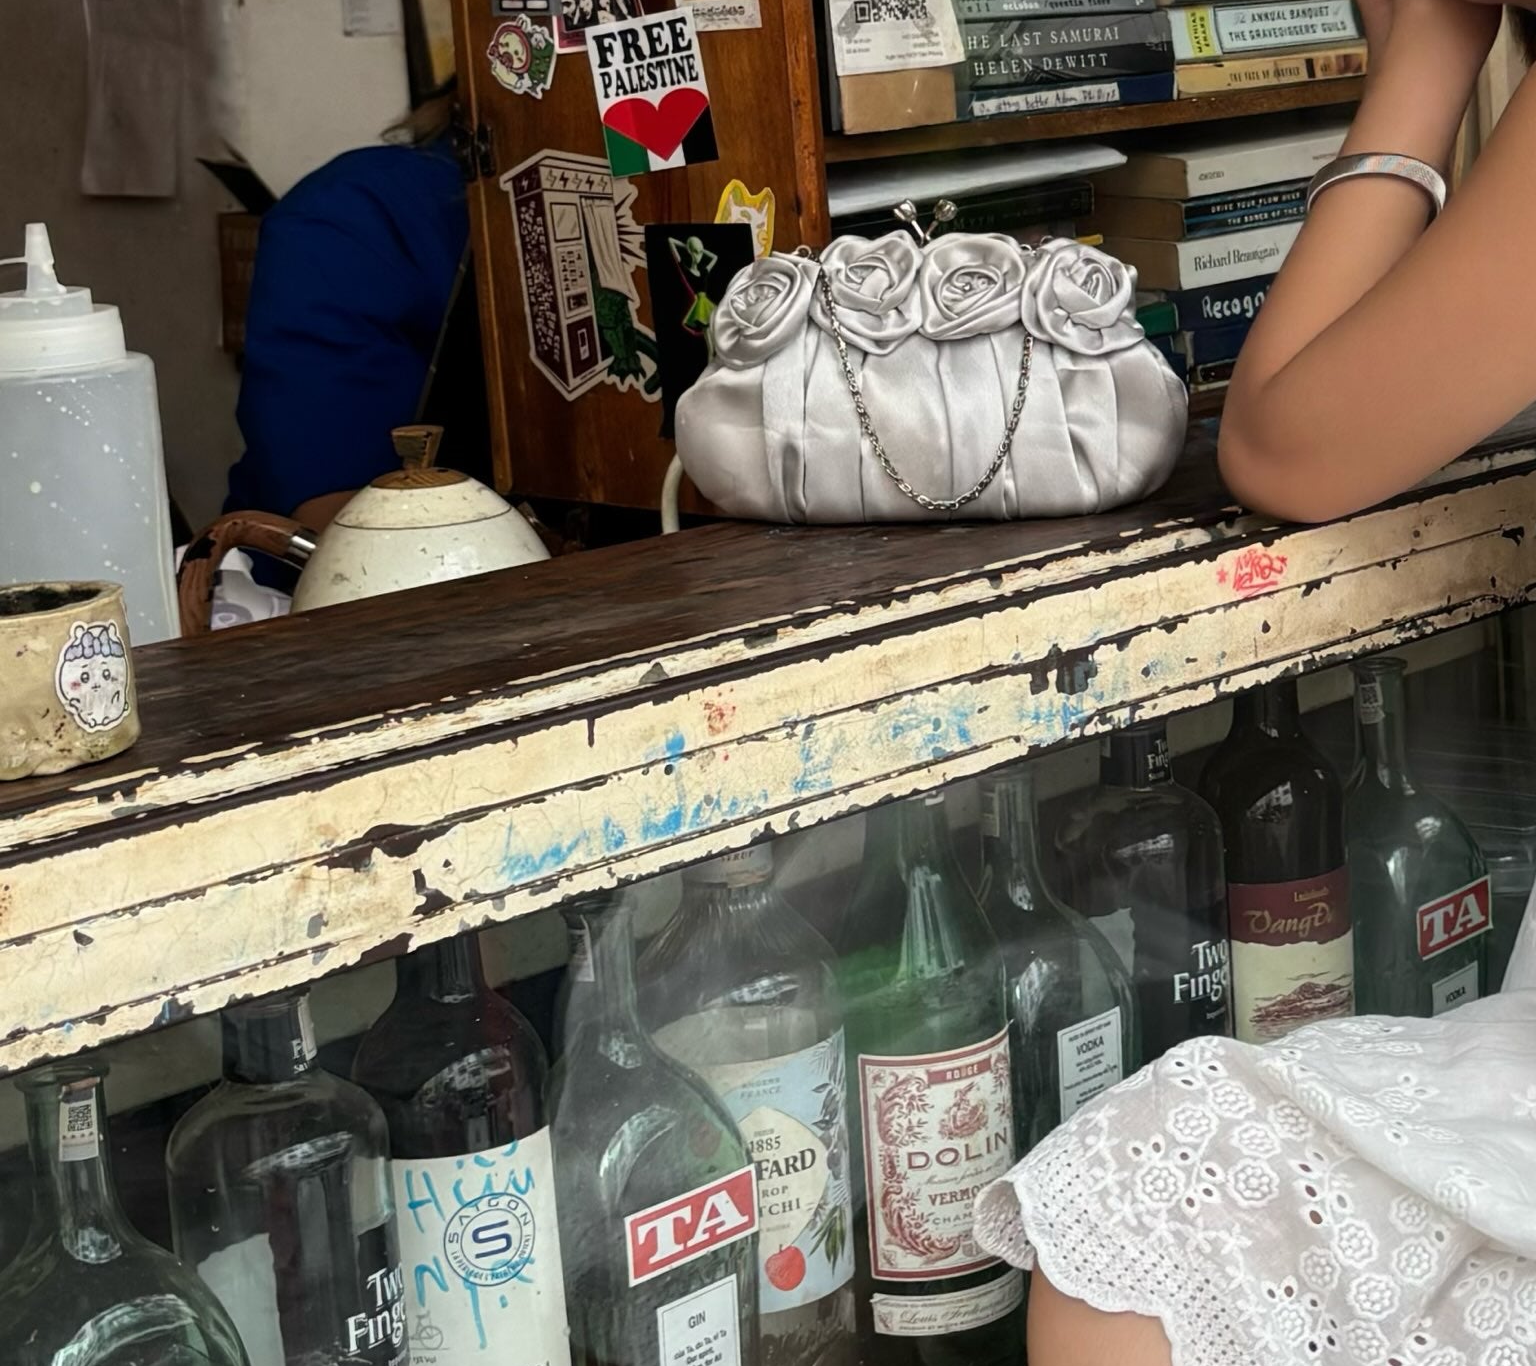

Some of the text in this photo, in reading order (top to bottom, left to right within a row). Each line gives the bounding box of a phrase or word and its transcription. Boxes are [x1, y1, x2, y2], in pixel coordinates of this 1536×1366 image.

[1289, 5, 1330, 20] BANQUET
[1322, 20, 1348, 33] GUILD
[591, 18, 695, 70] FREE
[967, 26, 1120, 51] HE LAST SAMURAI
[601, 54, 699, 98] PALESTINE
[974, 58, 1034, 77] HELEN
[1194, 250, 1231, 272] Richard
[1423, 893, 1486, 948] TA
[1076, 1036, 1104, 1056] VODKA
[946, 1064, 979, 1081] ROUGE
[750, 1136, 781, 1154] 1885
[906, 1127, 1009, 1171] DOLIN
[762, 1185, 789, 1198] ROP
[637, 1190, 749, 1265] TA
[688, 1310, 706, 1329] GIN
